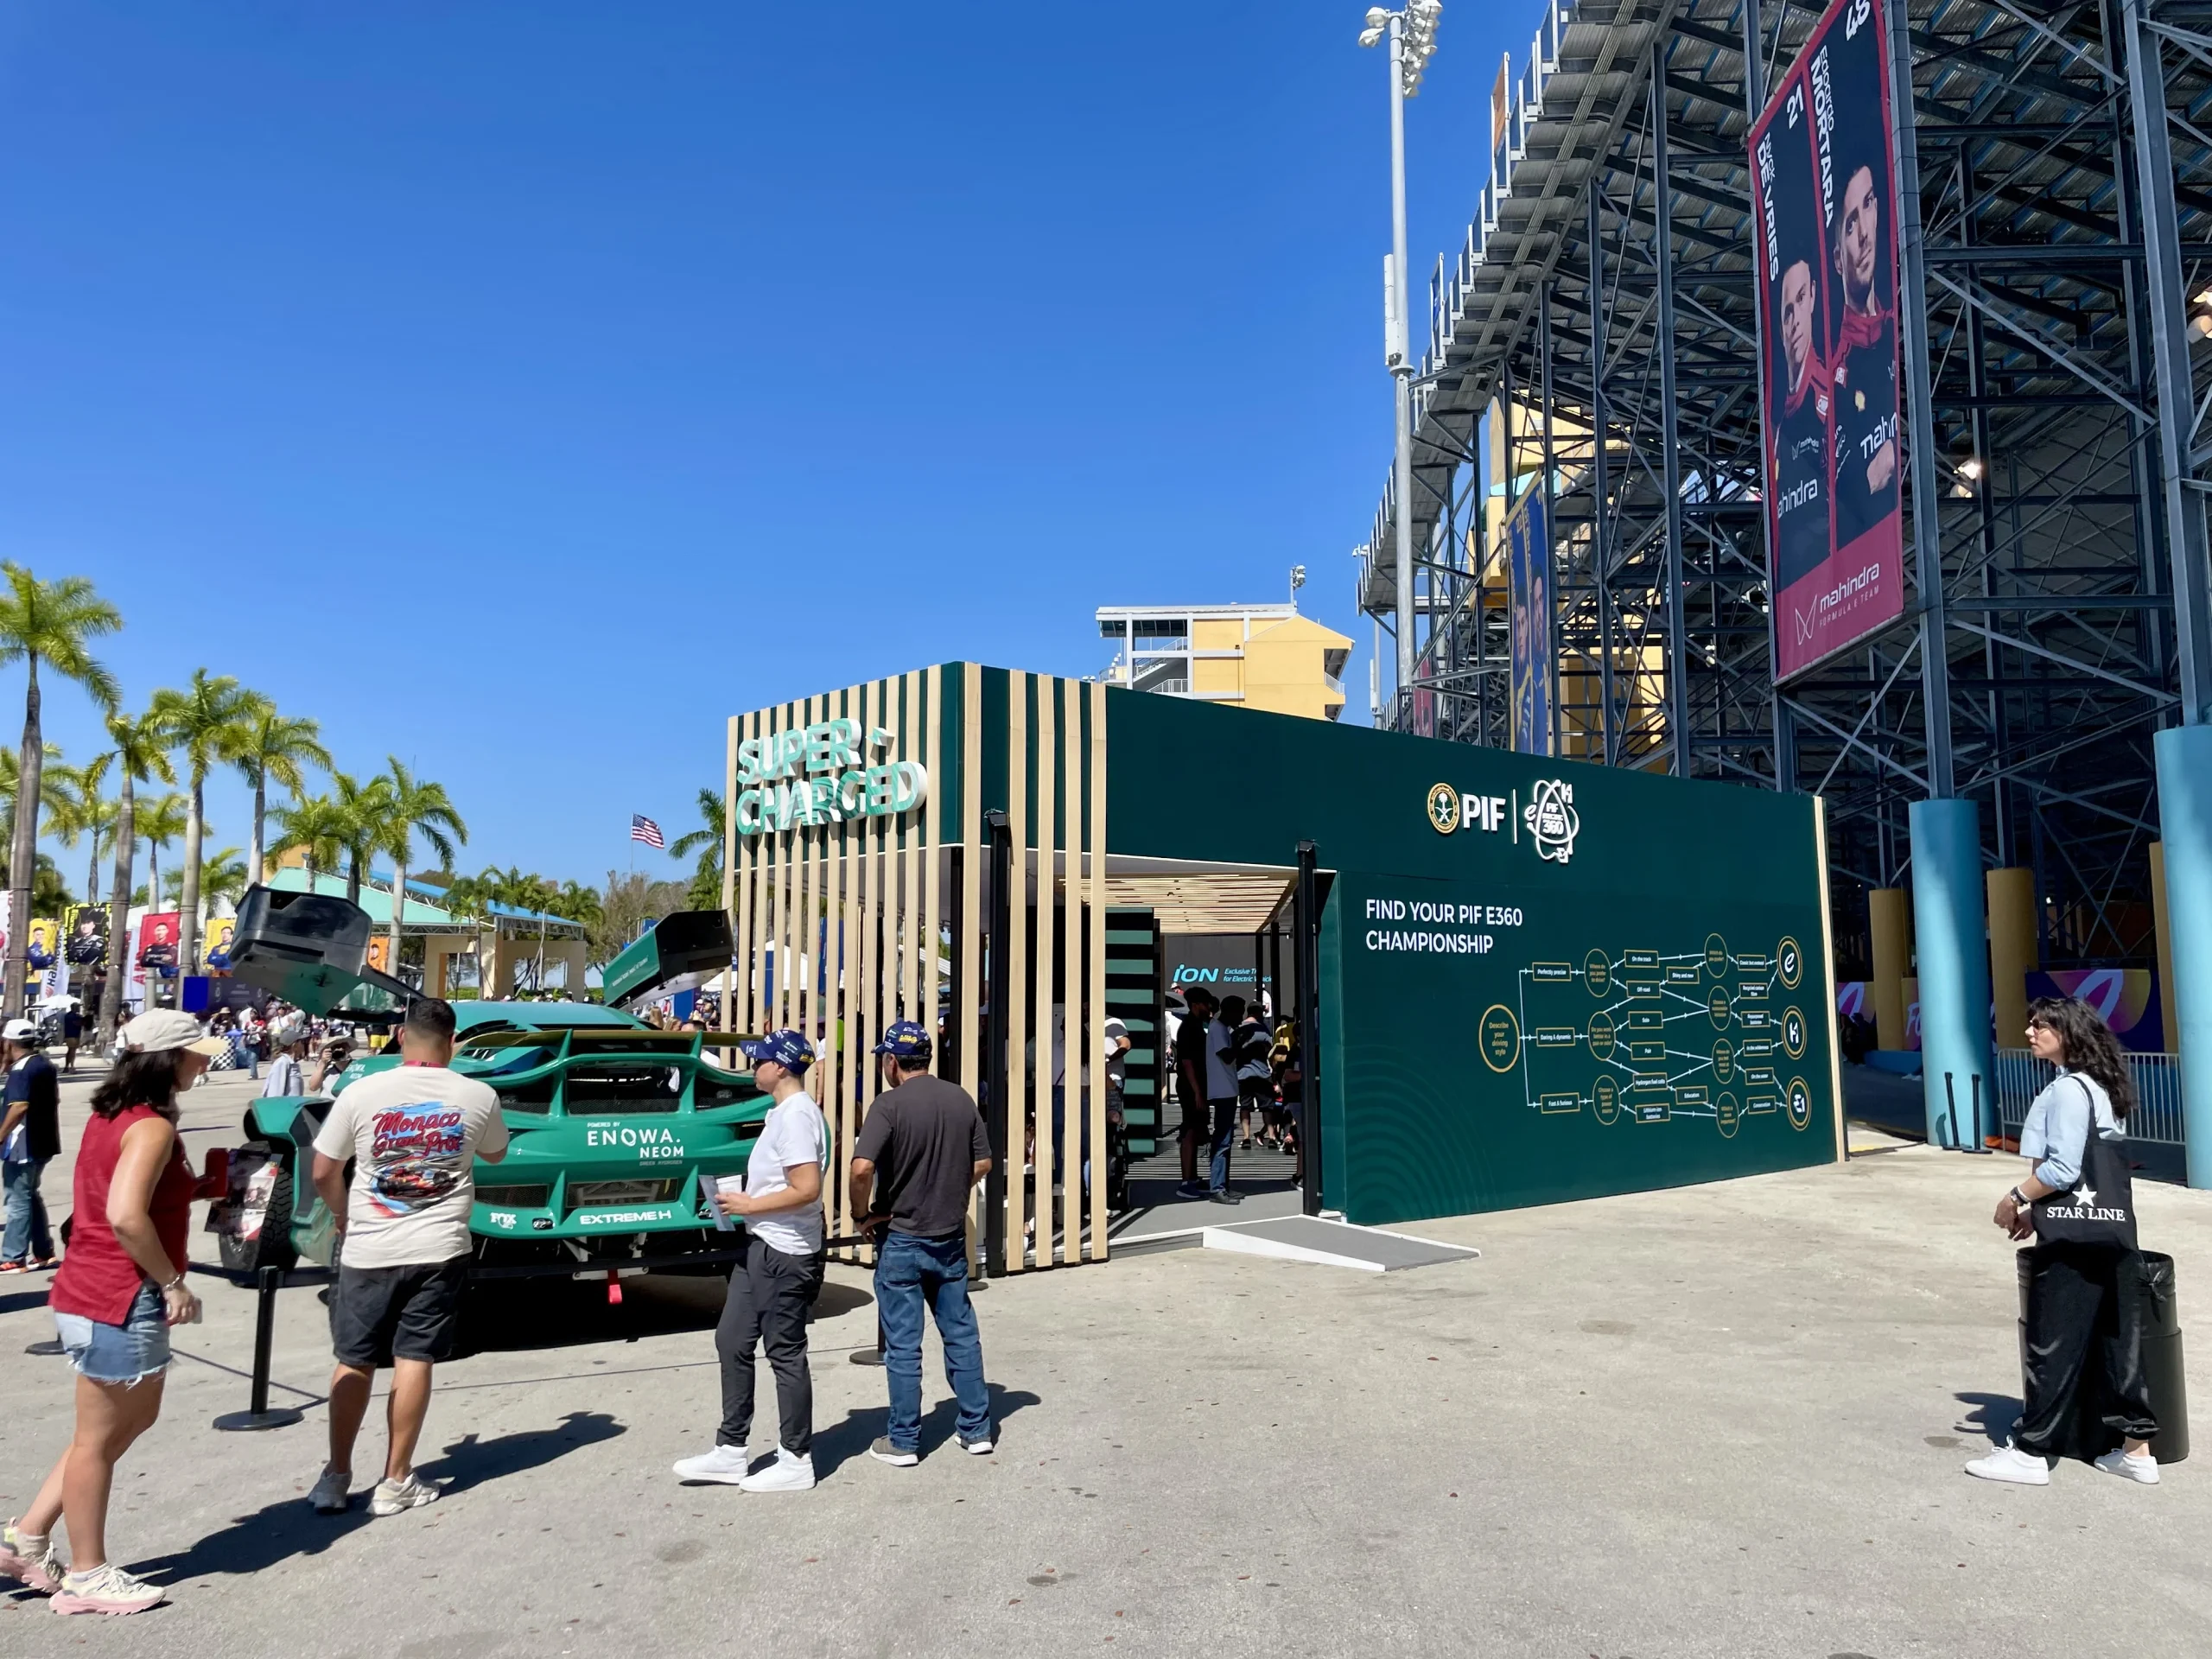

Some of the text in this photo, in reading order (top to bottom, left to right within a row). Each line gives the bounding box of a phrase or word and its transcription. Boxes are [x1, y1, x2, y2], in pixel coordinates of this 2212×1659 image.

[1787, 83, 1804, 130] 21
[1820, 45, 1834, 131] Edoardo
[1811, 55, 1834, 228] MORTARA
[1758, 141, 1778, 282] DE VRIES
[1819, 585, 1879, 628] FORMULA E TEAM
[1820, 563, 1879, 613] mahindra
[736, 717, 862, 785] SUPER
[735, 760, 928, 836] CHARGED
[1461, 793, 1506, 832] PIF
[1366, 899, 1523, 926] FIND YOUR PIF E360
[1365, 930, 1494, 954] CHAMPIONSHIP
[372, 1110, 461, 1137] Monaco
[372, 1131, 464, 1158] Grand Prix
[639, 1146, 684, 1158] NEOM
[490, 1211, 517, 1228] FOX
[580, 1210, 672, 1225] EXTREME H
[2046, 1206, 2126, 1222] STAR LINE
